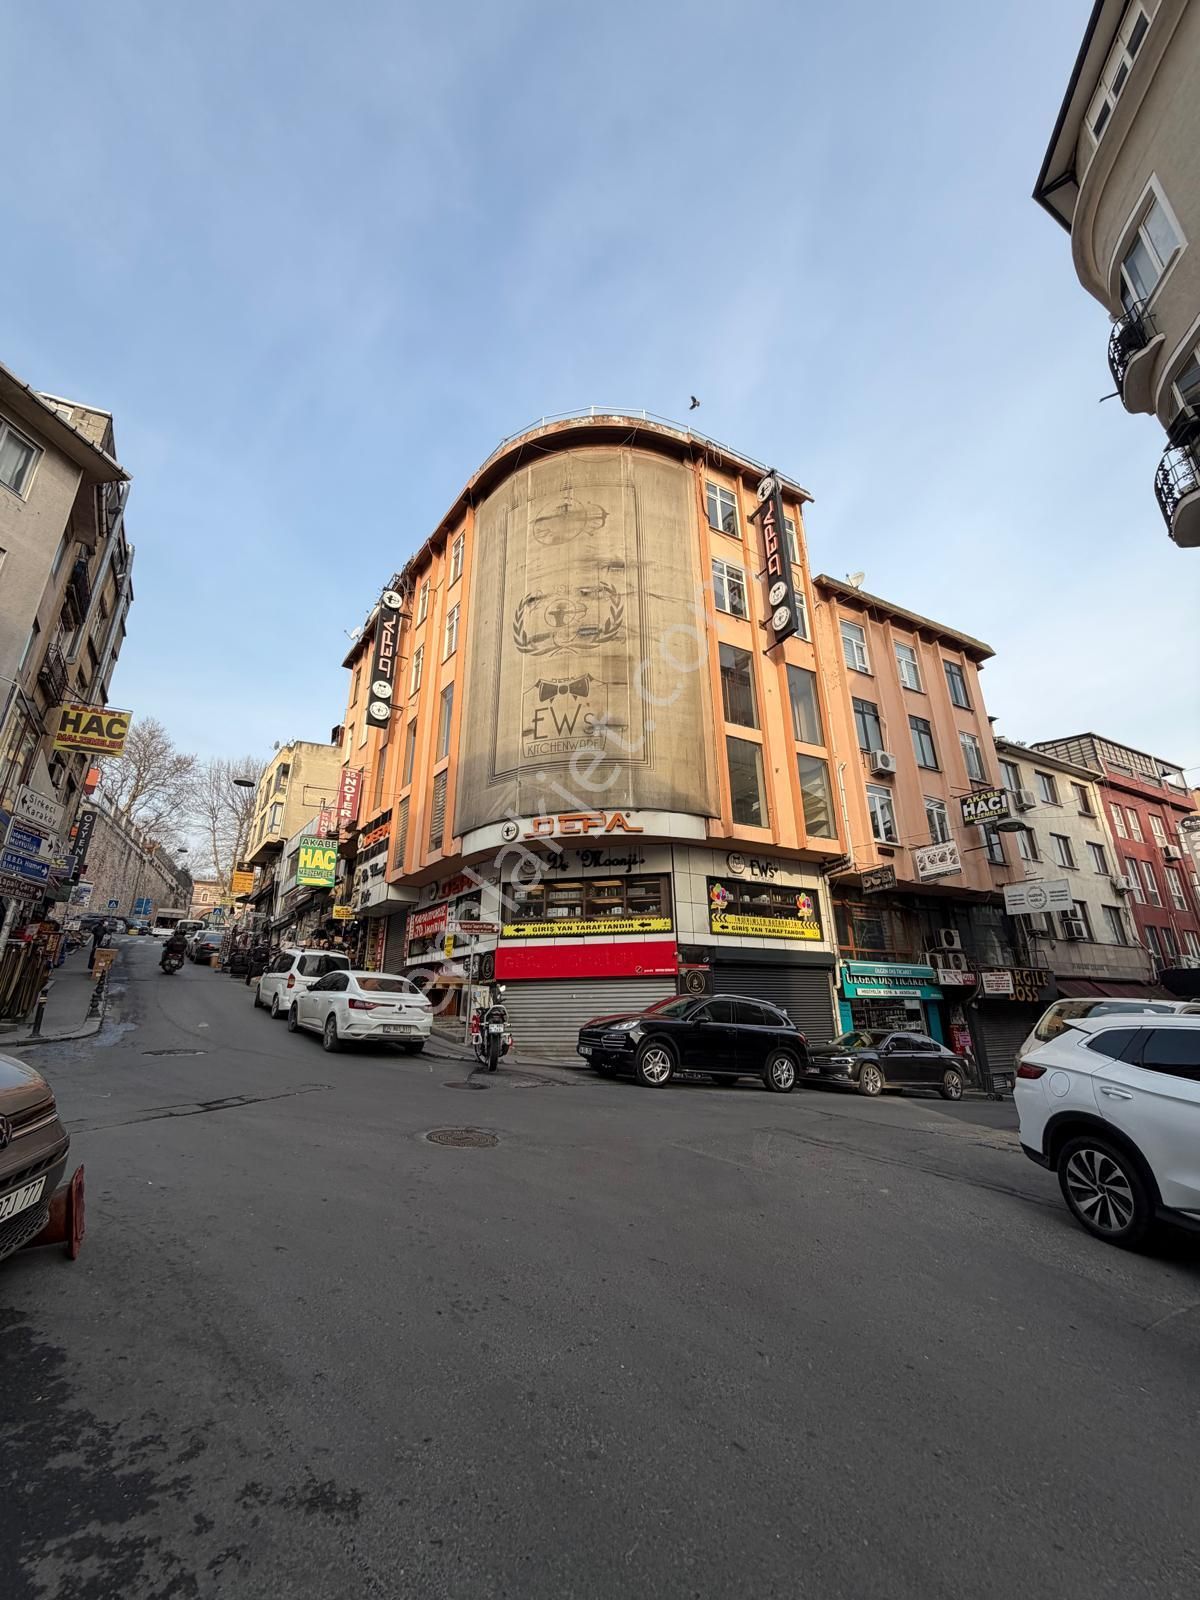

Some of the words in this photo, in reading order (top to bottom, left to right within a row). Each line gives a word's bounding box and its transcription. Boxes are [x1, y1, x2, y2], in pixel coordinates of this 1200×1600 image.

[763, 500, 782, 576] DEPA
[378, 614, 396, 679] DEPA
[59, 710, 127, 740] HAC
[29, 793, 57, 815] Sirkeci
[340, 778, 357, 818] NOTER
[963, 795, 1008, 817] HACI
[966, 791, 1002, 805] AKABE
[523, 811, 644, 839] DEPA
[302, 838, 337, 849] AKABE
[299, 848, 336, 871] HAC
[532, 925, 555, 933] GİRİŞ
[557, 924, 573, 932] YAN
[731, 924, 749, 933] GİRİŞ
[19, 1179, 44, 1210] 777
